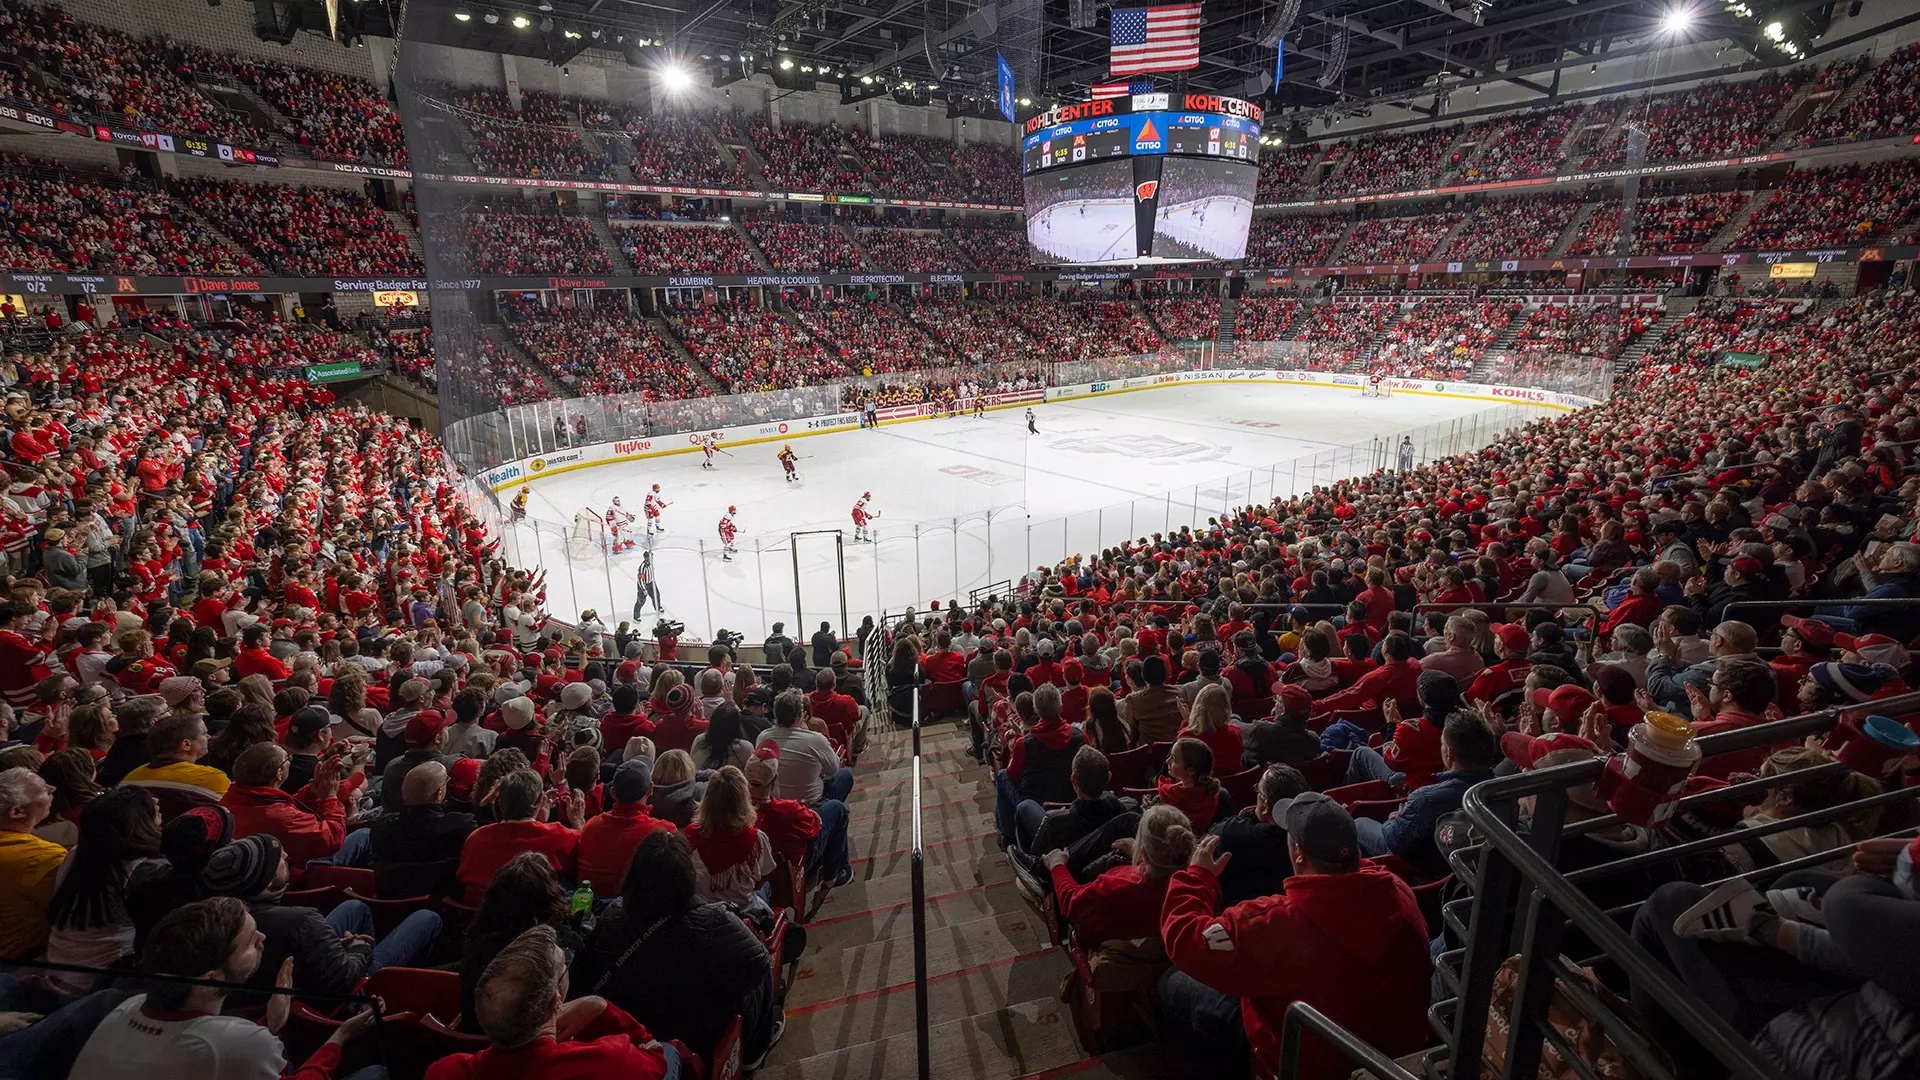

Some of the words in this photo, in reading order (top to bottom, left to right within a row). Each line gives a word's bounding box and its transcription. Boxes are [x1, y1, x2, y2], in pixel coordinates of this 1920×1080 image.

[1185, 94, 1226, 111] KOHL
[0, 106, 18, 119] 98
[26, 113, 54, 127] 2013
[1026, 111, 1051, 133] KOHL
[1053, 99, 1113, 123] CENTER
[1185, 115, 1204, 124] CITGO
[1097, 118, 1118, 128] CITGO
[1055, 126, 1072, 136] CITGO
[112, 132, 142, 143] TOYOTA
[185, 139, 208, 151] 6:35
[1136, 141, 1160, 150] CITGO
[256, 154, 278, 163] TOYOTA
[1743, 155, 1768, 164] 2014
[334, 163, 369, 174] NCAA
[1665, 159, 1728, 172] CHAMPIONS
[560, 279, 581, 287] Dave
[669, 277, 713, 286] PLUMBING
[747, 277, 780, 285] HEATING
[781, 277, 787, 285] &
[788, 276, 820, 285] COOLING
[866, 275, 905, 283] PROTECTION
[27, 281, 47, 293] 0/2
[200, 279, 228, 291] Dave
[230, 279, 260, 290] Jones
[334, 280, 376, 291] Serving
[376, 280, 411, 291] Badger
[435, 279, 459, 289] Since
[460, 279, 481, 289] 1977
[1184, 372, 1223, 380] NISSAN
[1492, 388, 1545, 401] KOHL'S
[488, 466, 521, 486] Health
[615, 938, 643, 967] UNDER
